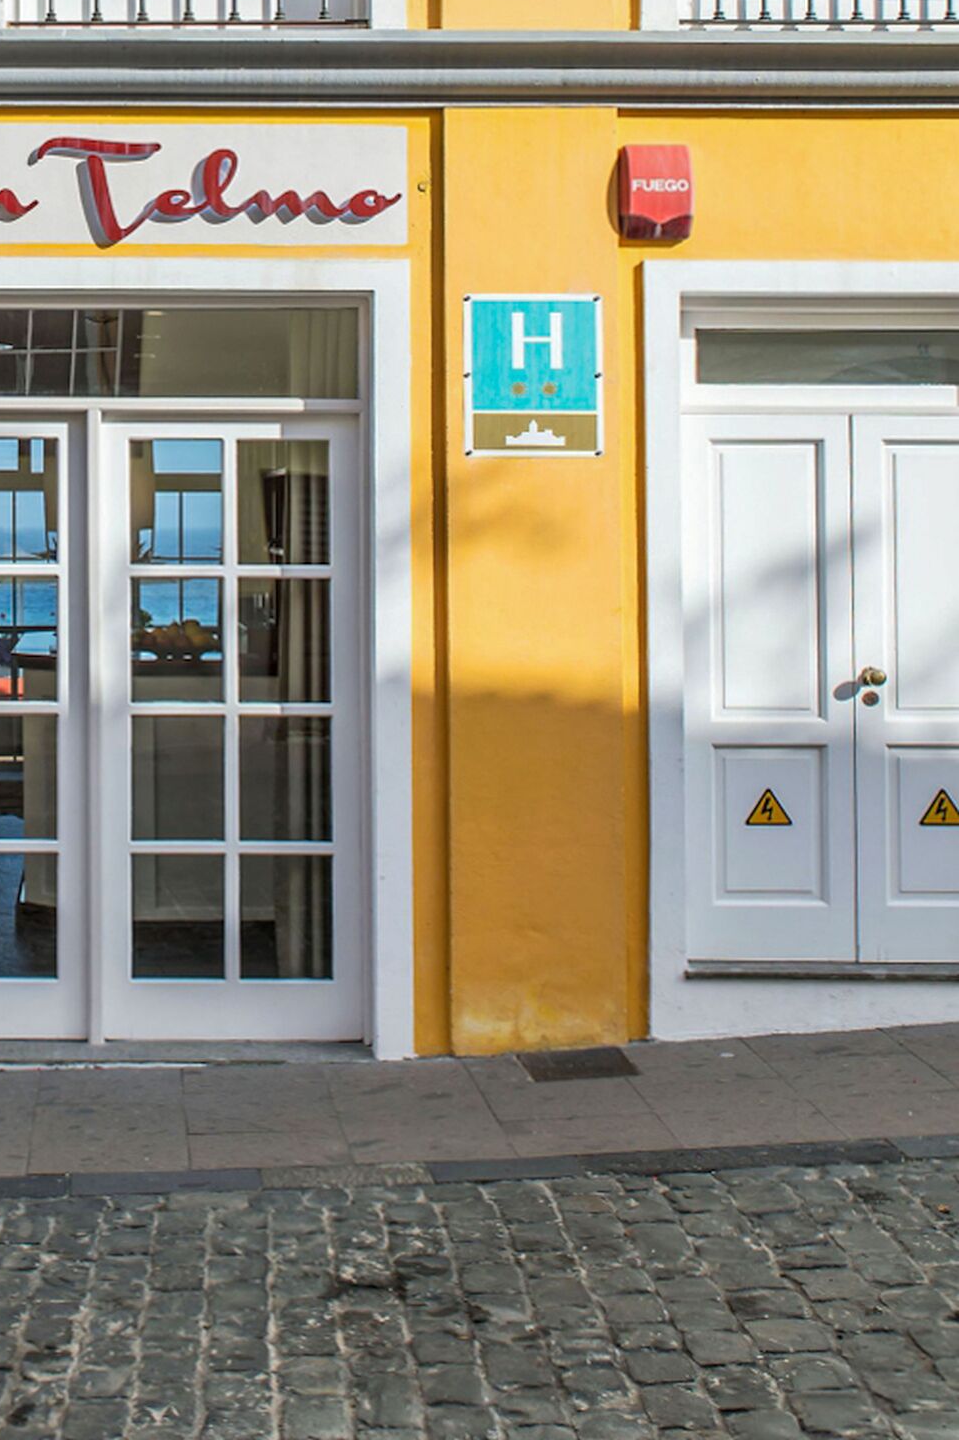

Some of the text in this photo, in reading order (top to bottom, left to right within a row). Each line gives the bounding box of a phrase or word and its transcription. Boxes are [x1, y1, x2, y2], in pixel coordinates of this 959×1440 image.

[27, 137, 403, 250] Telmo
[632, 178, 689, 192] FUEGO
[511, 312, 563, 369] H
